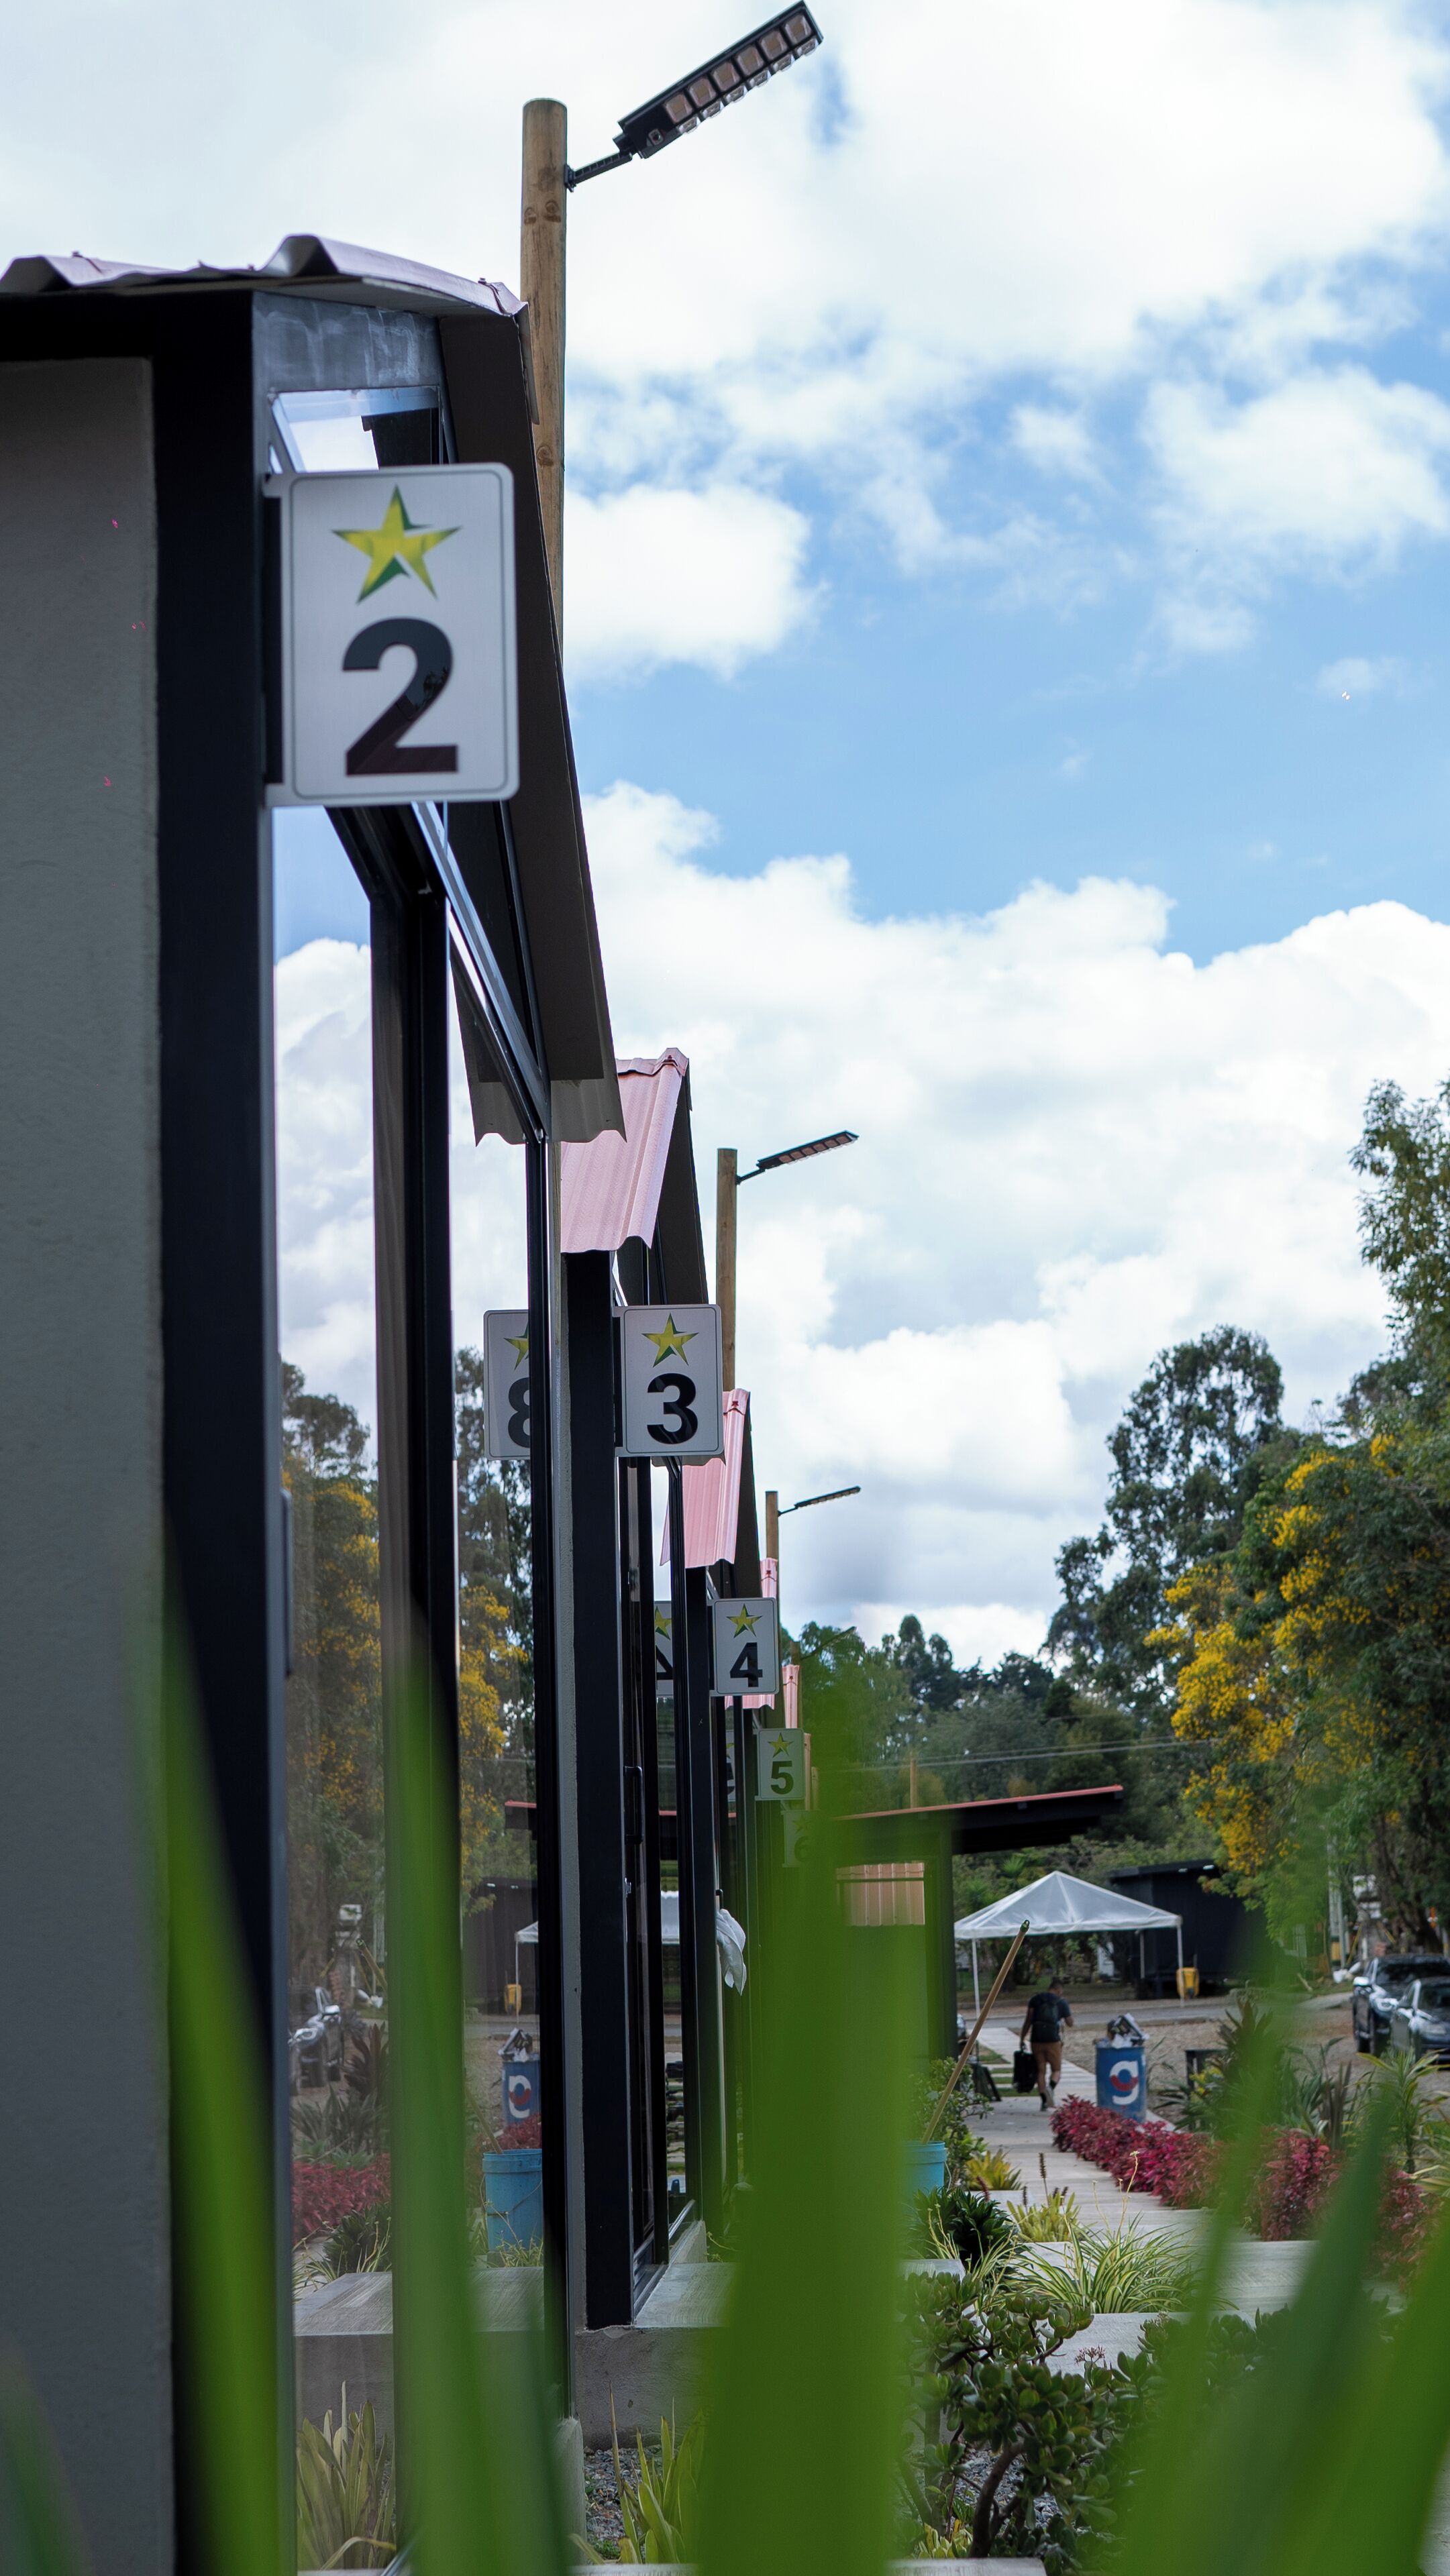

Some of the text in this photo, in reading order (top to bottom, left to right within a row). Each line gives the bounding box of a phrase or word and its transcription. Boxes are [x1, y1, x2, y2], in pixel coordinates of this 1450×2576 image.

[342, 617, 459, 777] 2
[647, 1373, 698, 1444] 3
[730, 1642, 763, 1687] 4
[770, 1760, 794, 1794] 5
[1109, 2060, 1140, 2105] g
